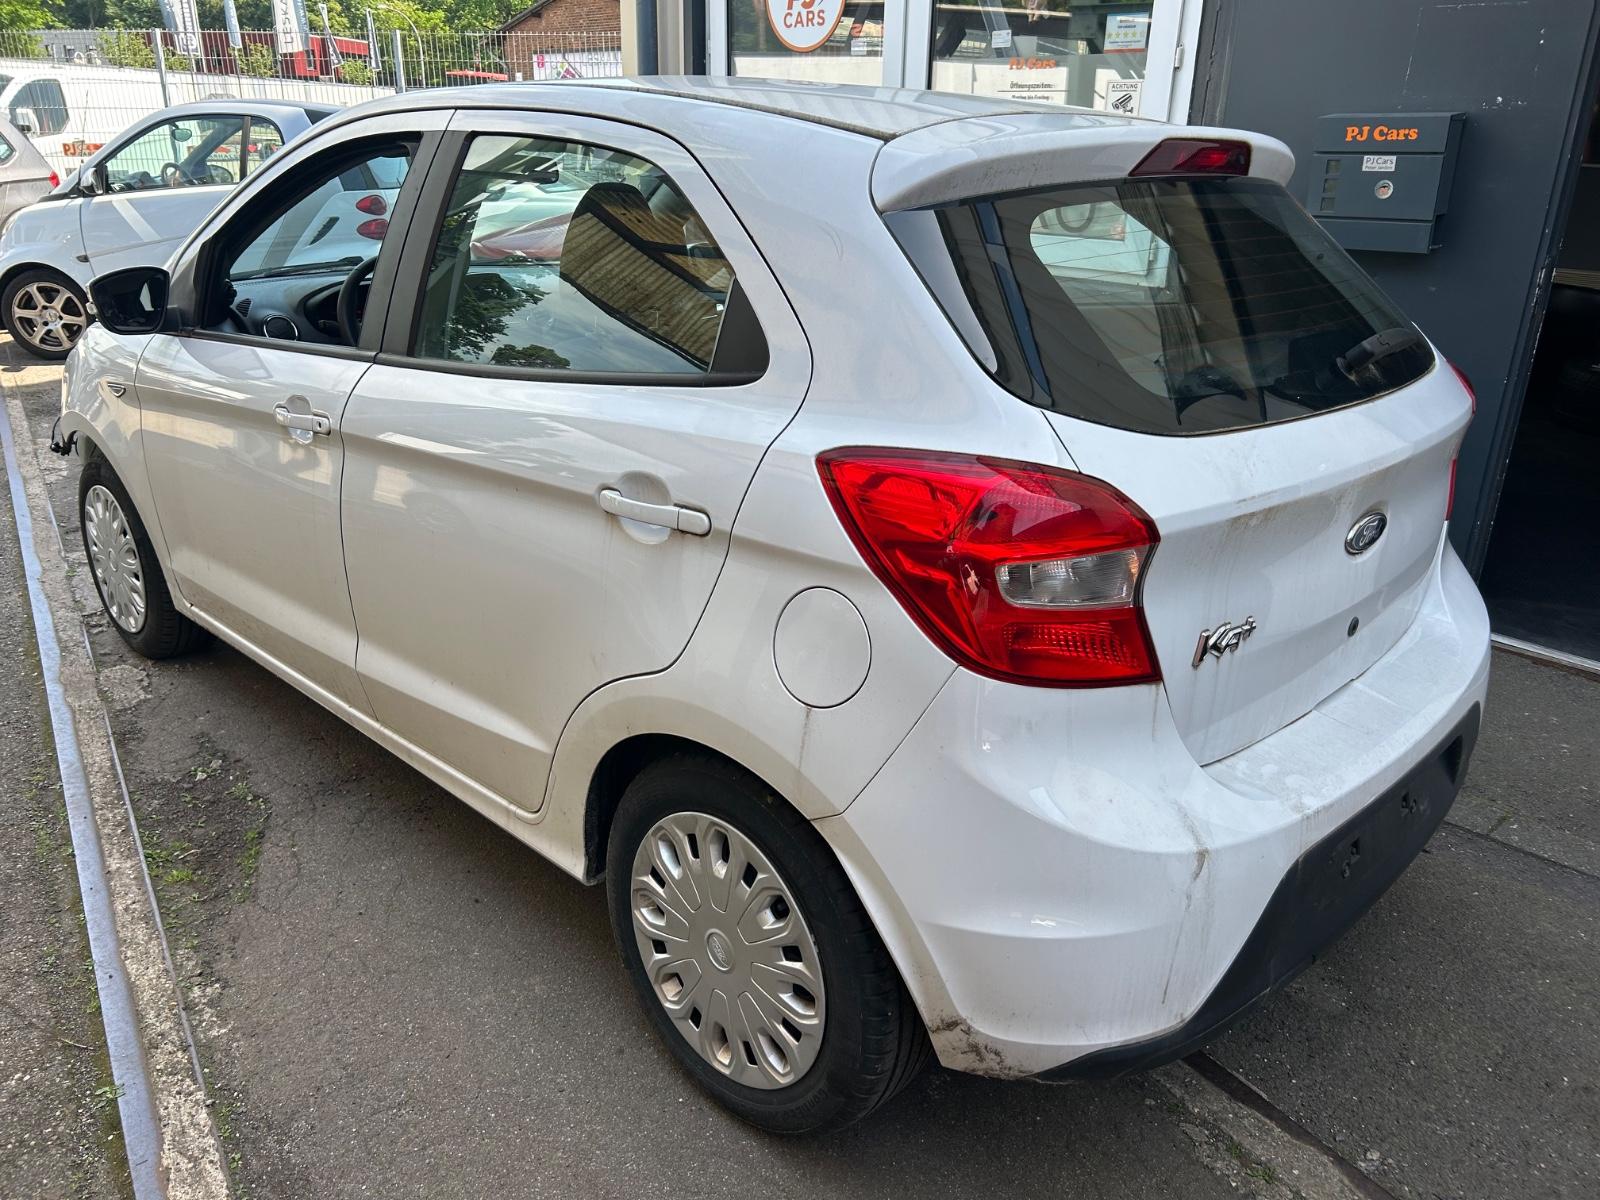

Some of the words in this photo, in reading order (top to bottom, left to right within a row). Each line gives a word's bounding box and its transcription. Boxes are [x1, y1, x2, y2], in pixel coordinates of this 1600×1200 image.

[783, 9, 825, 28] CARS
[1027, 56, 1057, 70] Cars
[1345, 126, 1371, 141] PJ
[1373, 125, 1418, 141] Cars
[1365, 157, 1375, 165] PJ
[1376, 156, 1394, 165] Cars
